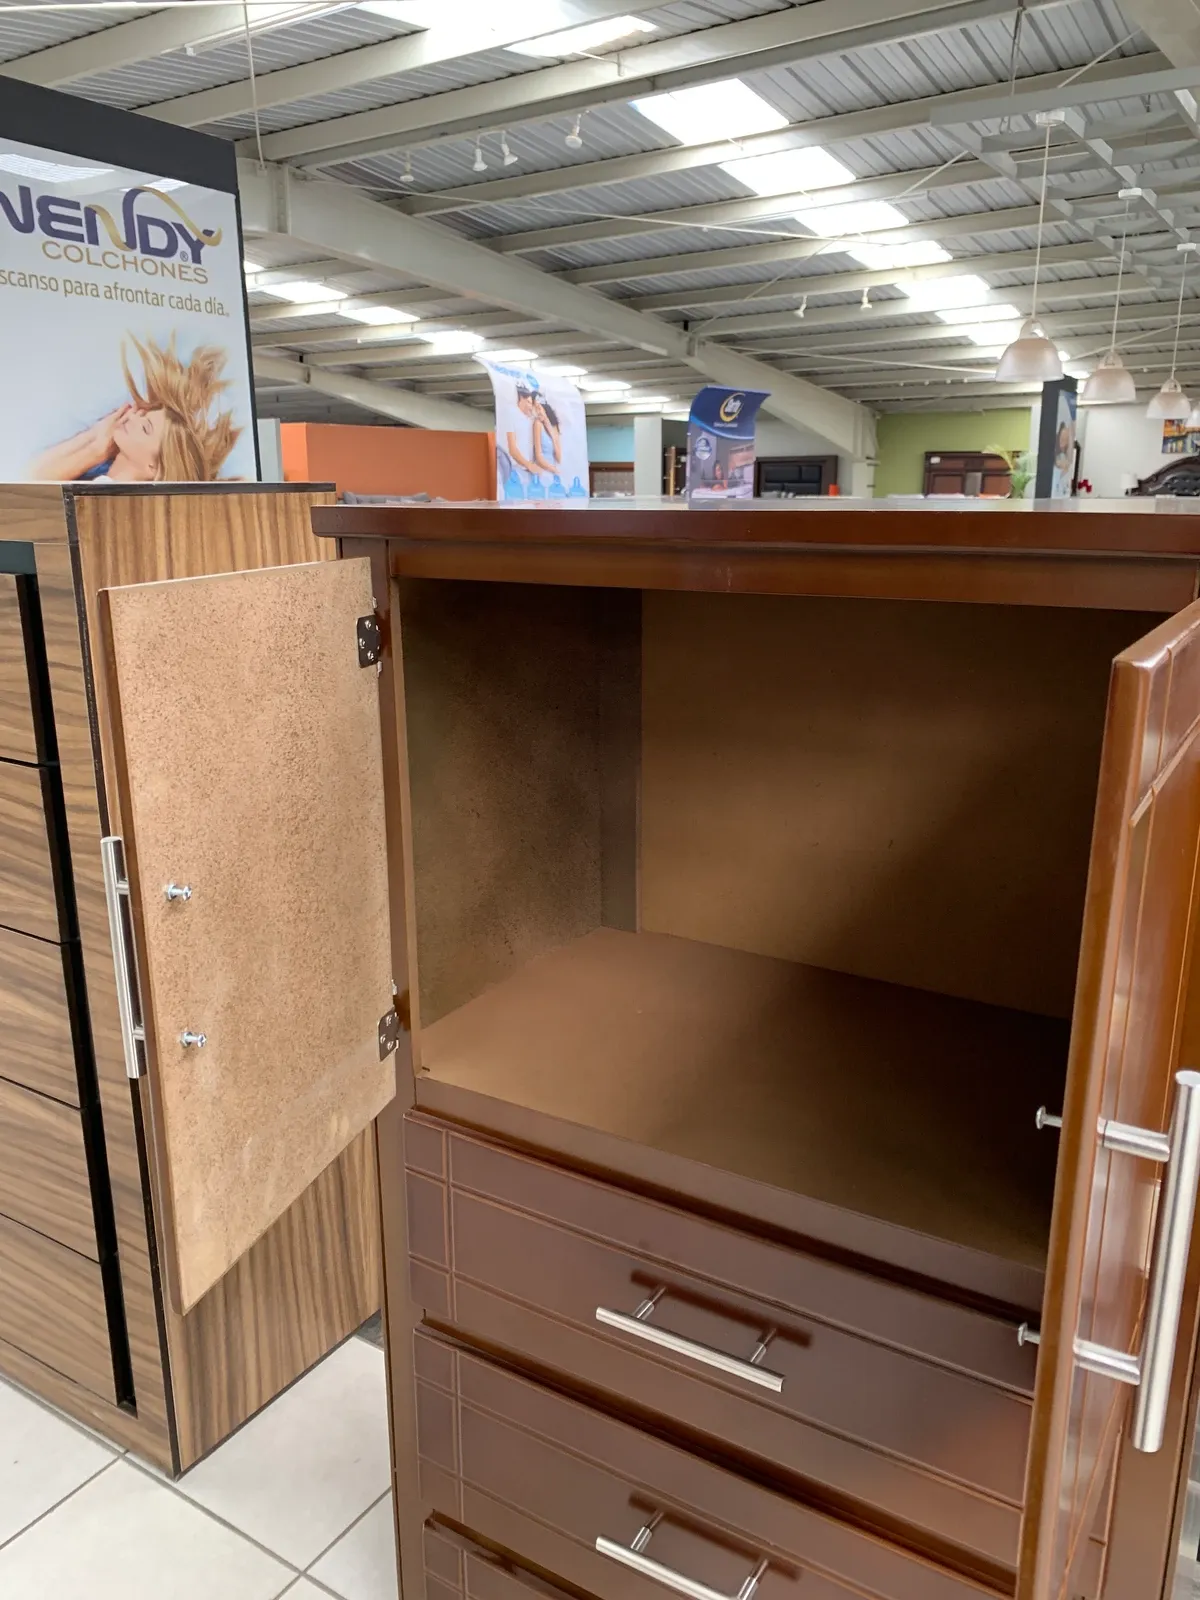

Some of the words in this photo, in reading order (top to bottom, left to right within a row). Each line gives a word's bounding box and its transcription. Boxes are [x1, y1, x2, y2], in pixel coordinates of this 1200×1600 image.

[42, 240, 209, 284] COLCHONES
[63, 278, 100, 297] para
[104, 281, 165, 307] afrontar
[168, 293, 202, 313] cada
